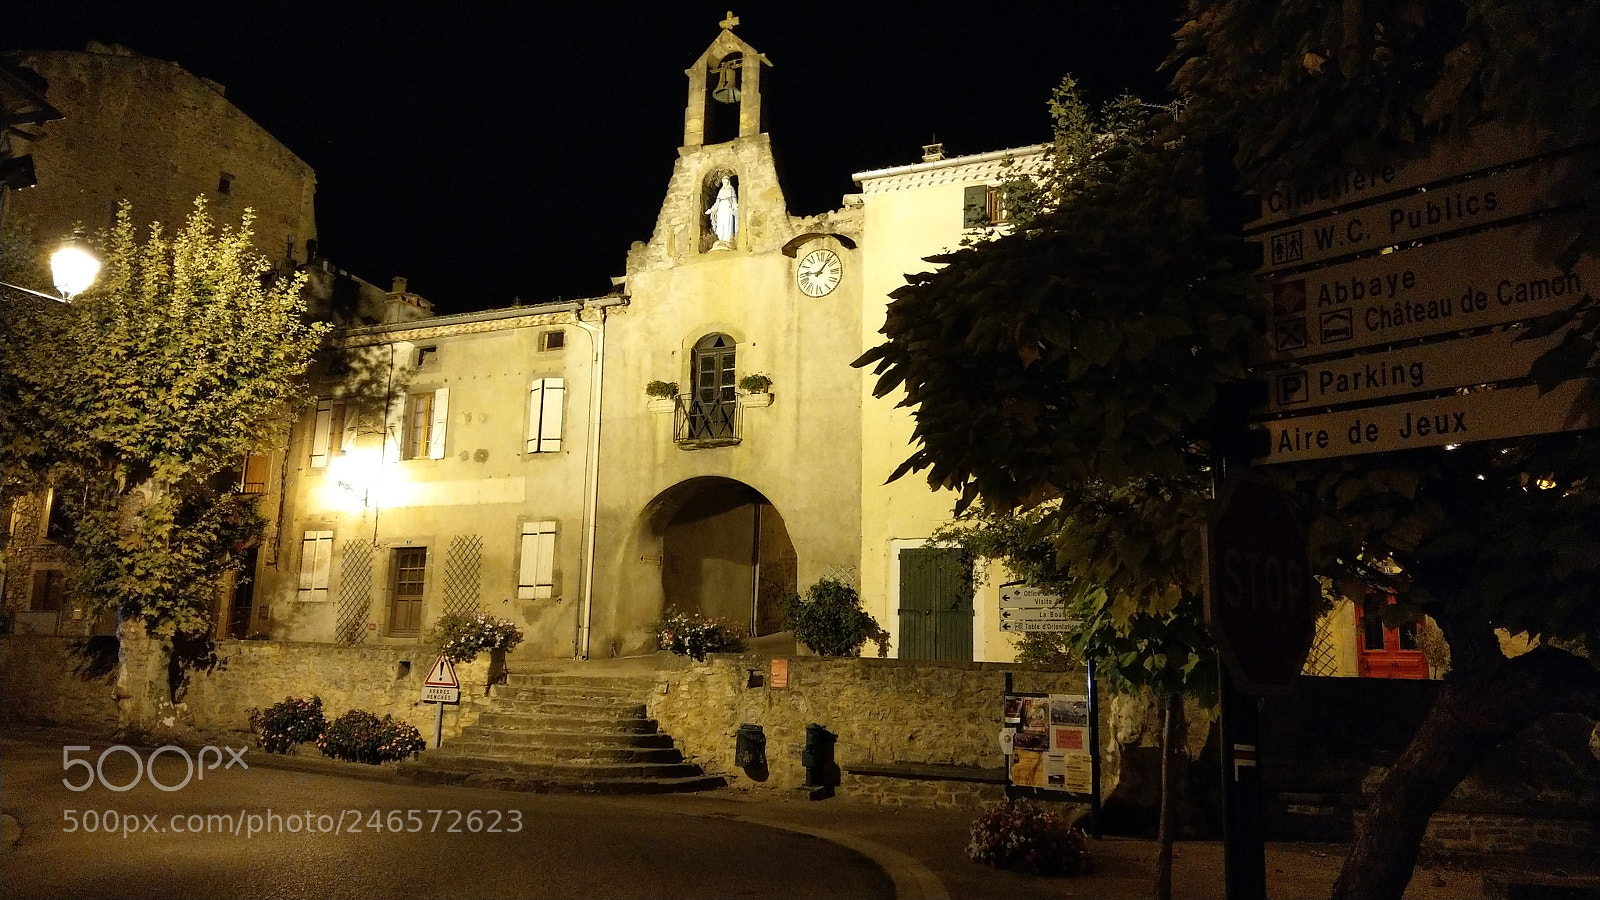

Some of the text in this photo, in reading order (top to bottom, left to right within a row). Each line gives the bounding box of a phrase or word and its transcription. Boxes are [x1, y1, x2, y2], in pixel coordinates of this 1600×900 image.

[1314, 190, 1498, 251] W.C. Publics
[1317, 269, 1416, 308] Abbaye
[1365, 271, 1582, 332] Château de Camon
[1319, 361, 1425, 396] Parking
[1278, 411, 1468, 453] Aire de Jeux
[1223, 549, 1302, 617] STOP
